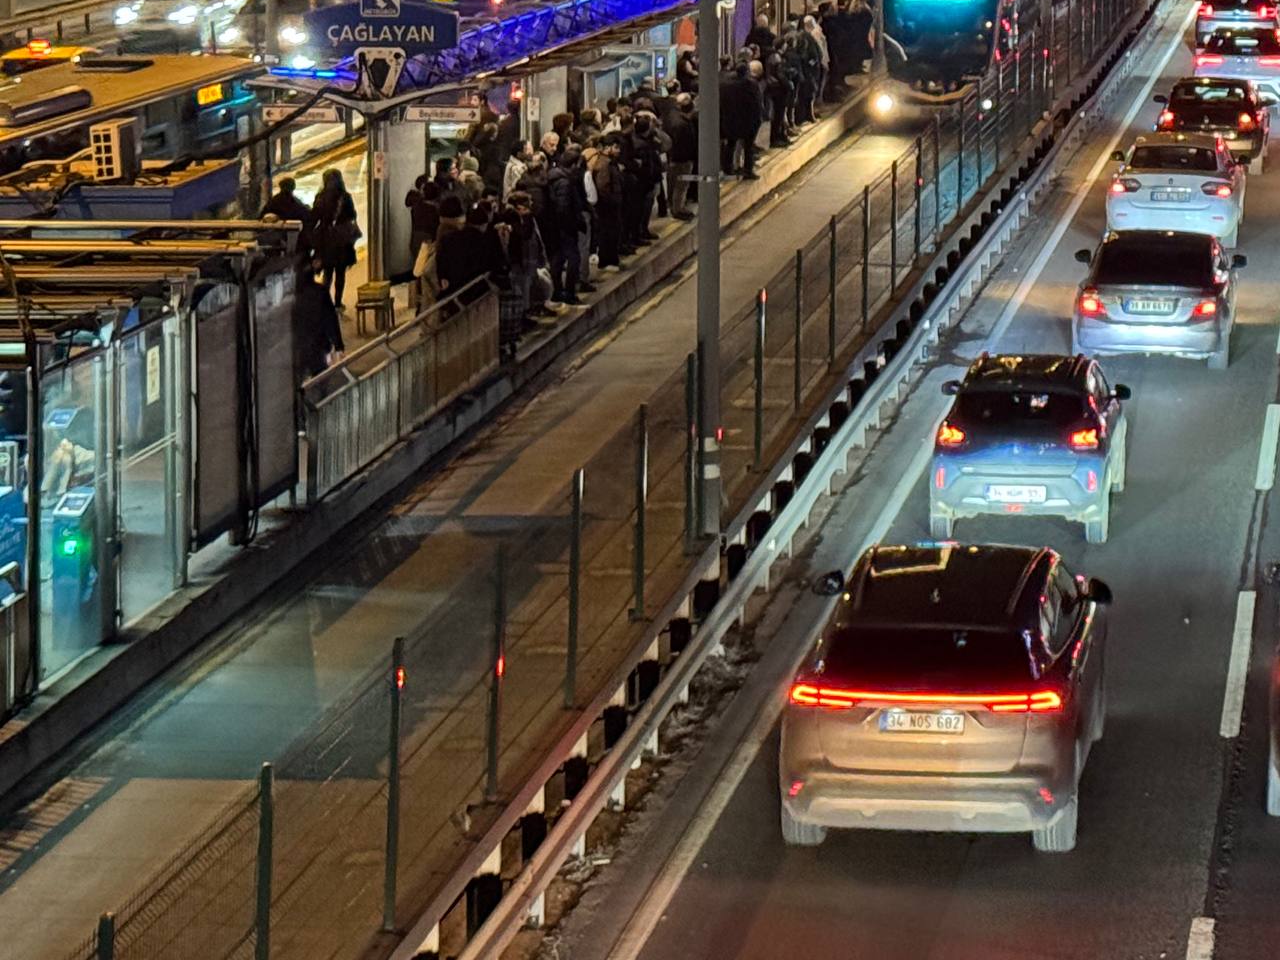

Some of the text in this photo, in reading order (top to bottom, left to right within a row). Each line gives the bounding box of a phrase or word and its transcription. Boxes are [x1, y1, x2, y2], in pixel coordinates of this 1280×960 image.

[327, 22, 435, 47] ÇAĞLAYAN
[888, 714, 904, 728] 34
[909, 714, 932, 729] NOS
